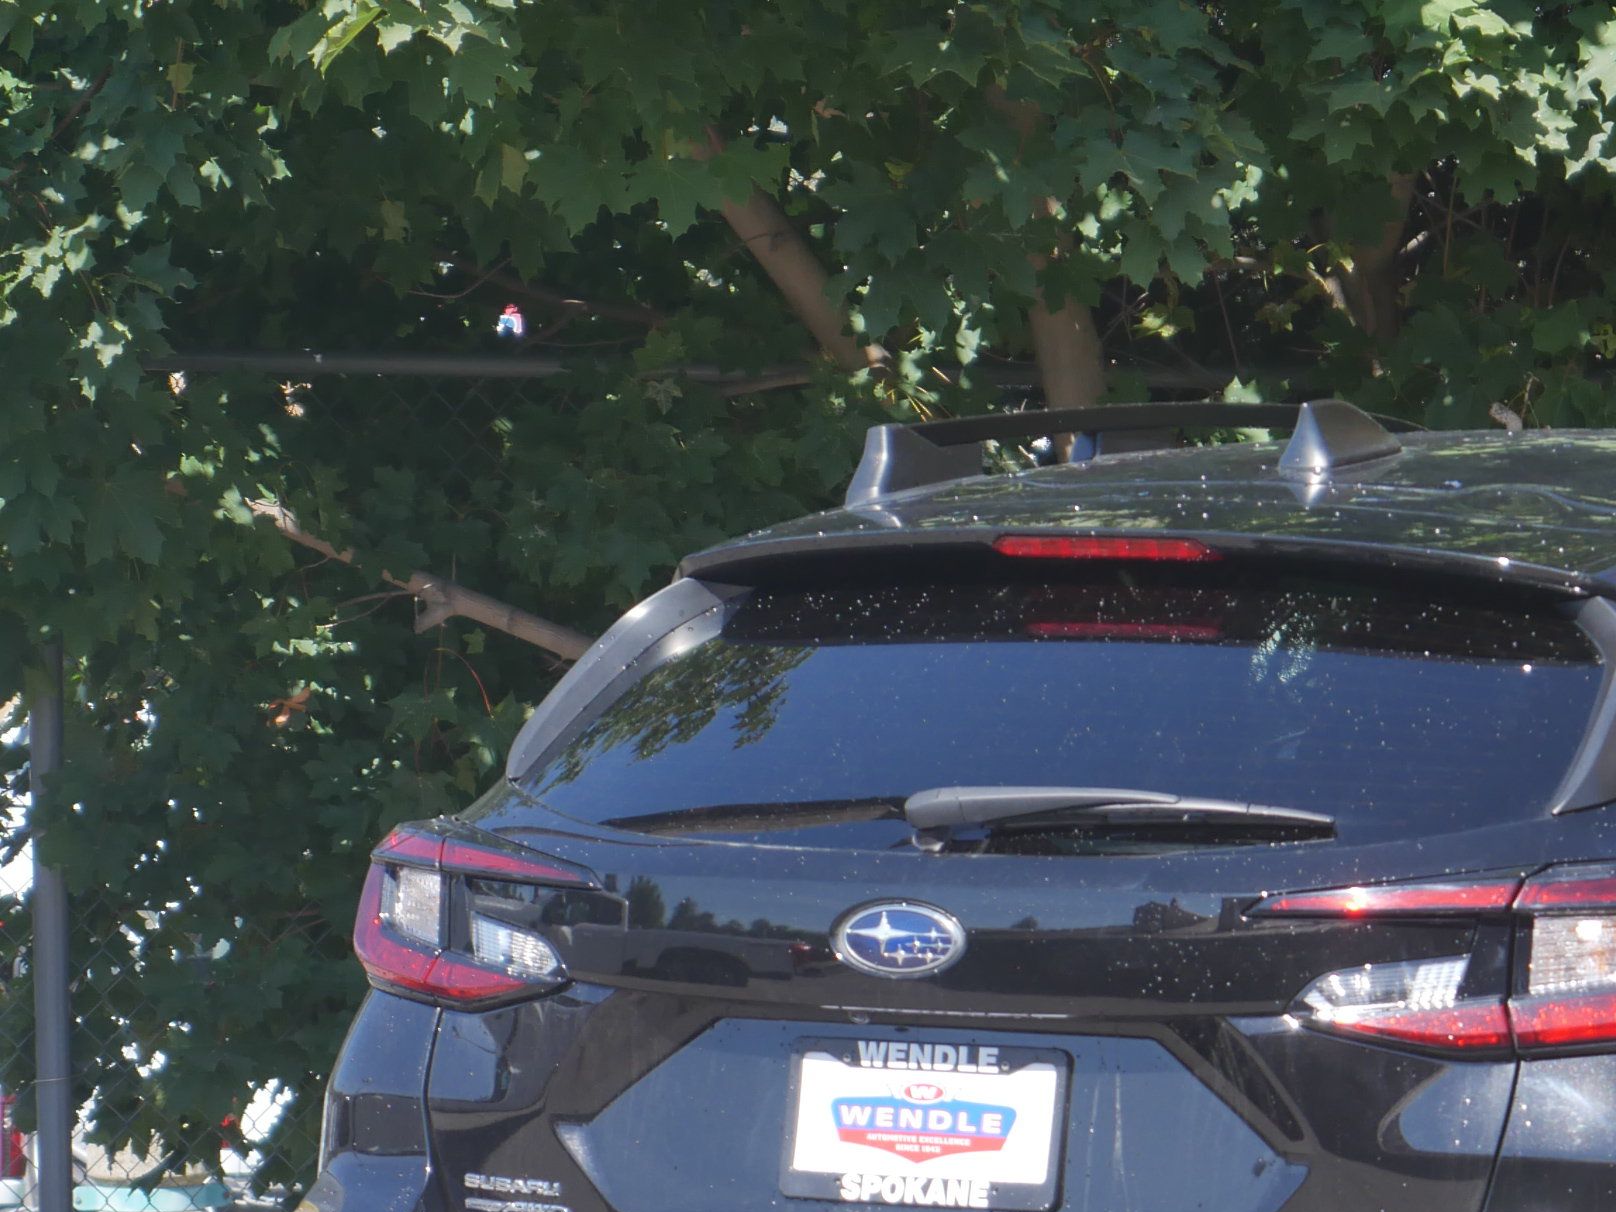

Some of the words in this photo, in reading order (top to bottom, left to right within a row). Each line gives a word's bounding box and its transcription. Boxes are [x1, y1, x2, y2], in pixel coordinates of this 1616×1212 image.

[858, 1040, 1000, 1074] WENDLE
[839, 1104, 1003, 1135] WENDLE
[464, 1172, 561, 1197] SUBARU
[840, 1172, 990, 1208] SPOKANE
